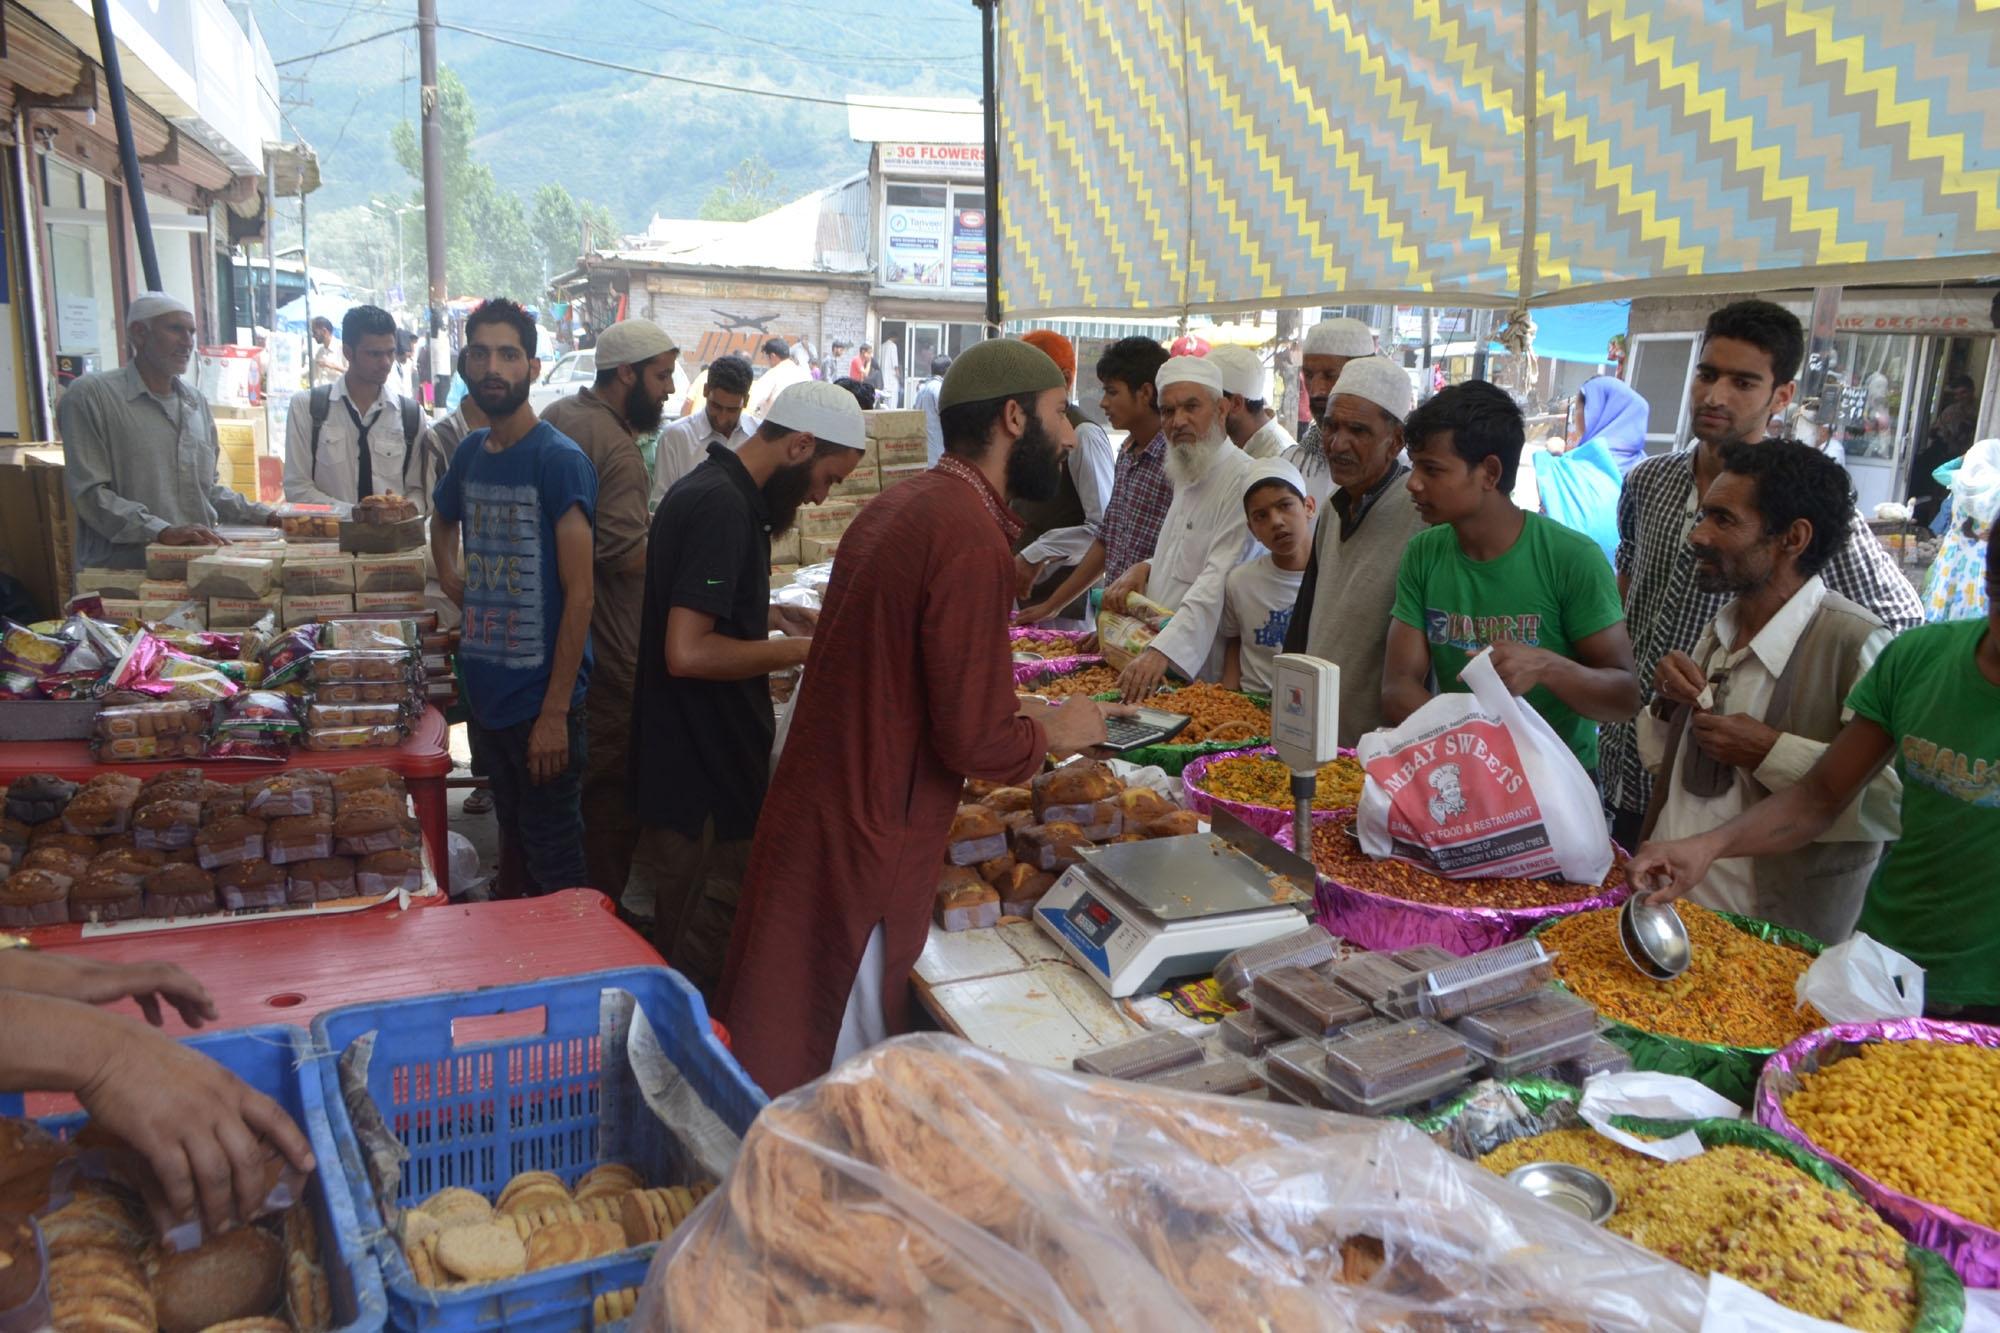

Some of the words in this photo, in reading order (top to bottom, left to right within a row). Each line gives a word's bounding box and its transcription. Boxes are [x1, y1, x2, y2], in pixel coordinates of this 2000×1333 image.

[897, 146, 915, 159] 3G
[1445, 733, 1524, 794] SWEETS
[1438, 825, 1463, 840] FOOD
[1465, 822, 1472, 833] &
[1473, 806, 1533, 832] RESTAURANT
[1439, 851, 1485, 869] ONFECTIONERY
